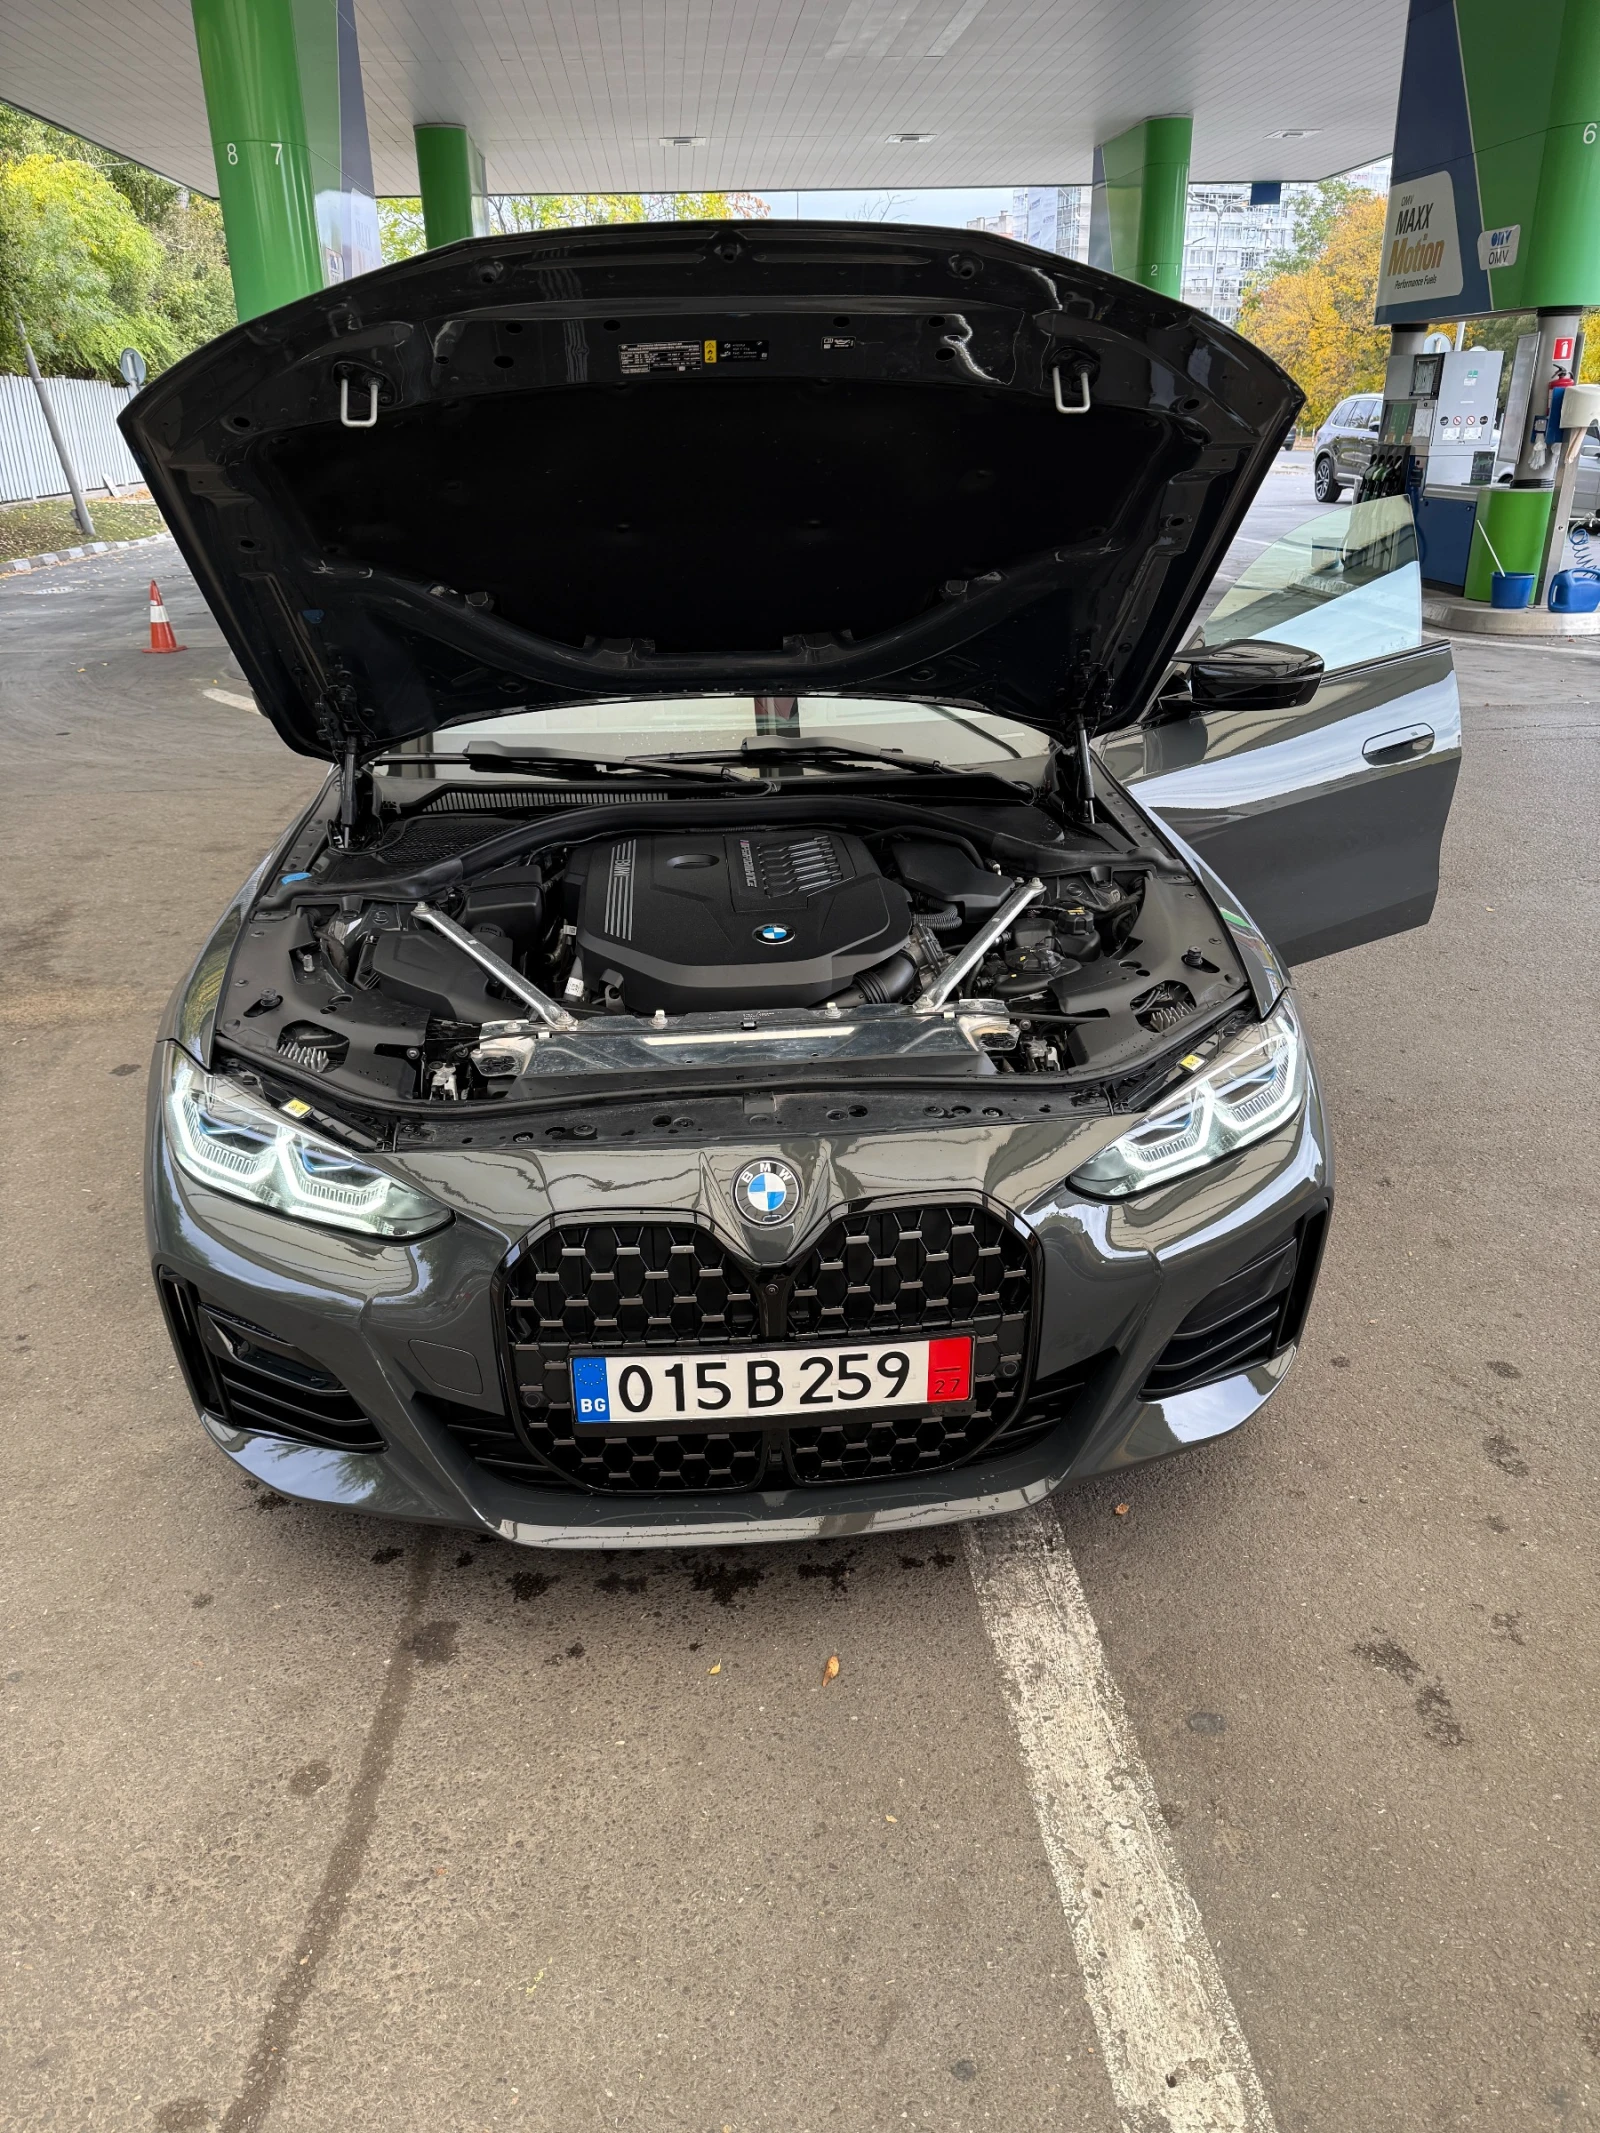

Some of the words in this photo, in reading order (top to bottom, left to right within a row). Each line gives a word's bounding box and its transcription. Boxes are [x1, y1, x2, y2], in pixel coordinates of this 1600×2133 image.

[1583, 122, 1597, 144] 6
[227, 143, 238, 165] 8
[270, 143, 282, 165] 7
[1395, 202, 1434, 235] MAXX
[1387, 237, 1445, 276] Motion
[1488, 249, 1509, 264] OMV
[1150, 264, 1158, 276] 2
[1175, 264, 1179, 276] 1
[1395, 278, 1423, 289] Performance
[1423, 274, 1437, 285] Fuels
[741, 1162, 792, 1184] BMW
[934, 1378, 961, 1395] 27
[580, 1398, 606, 1413] BG
